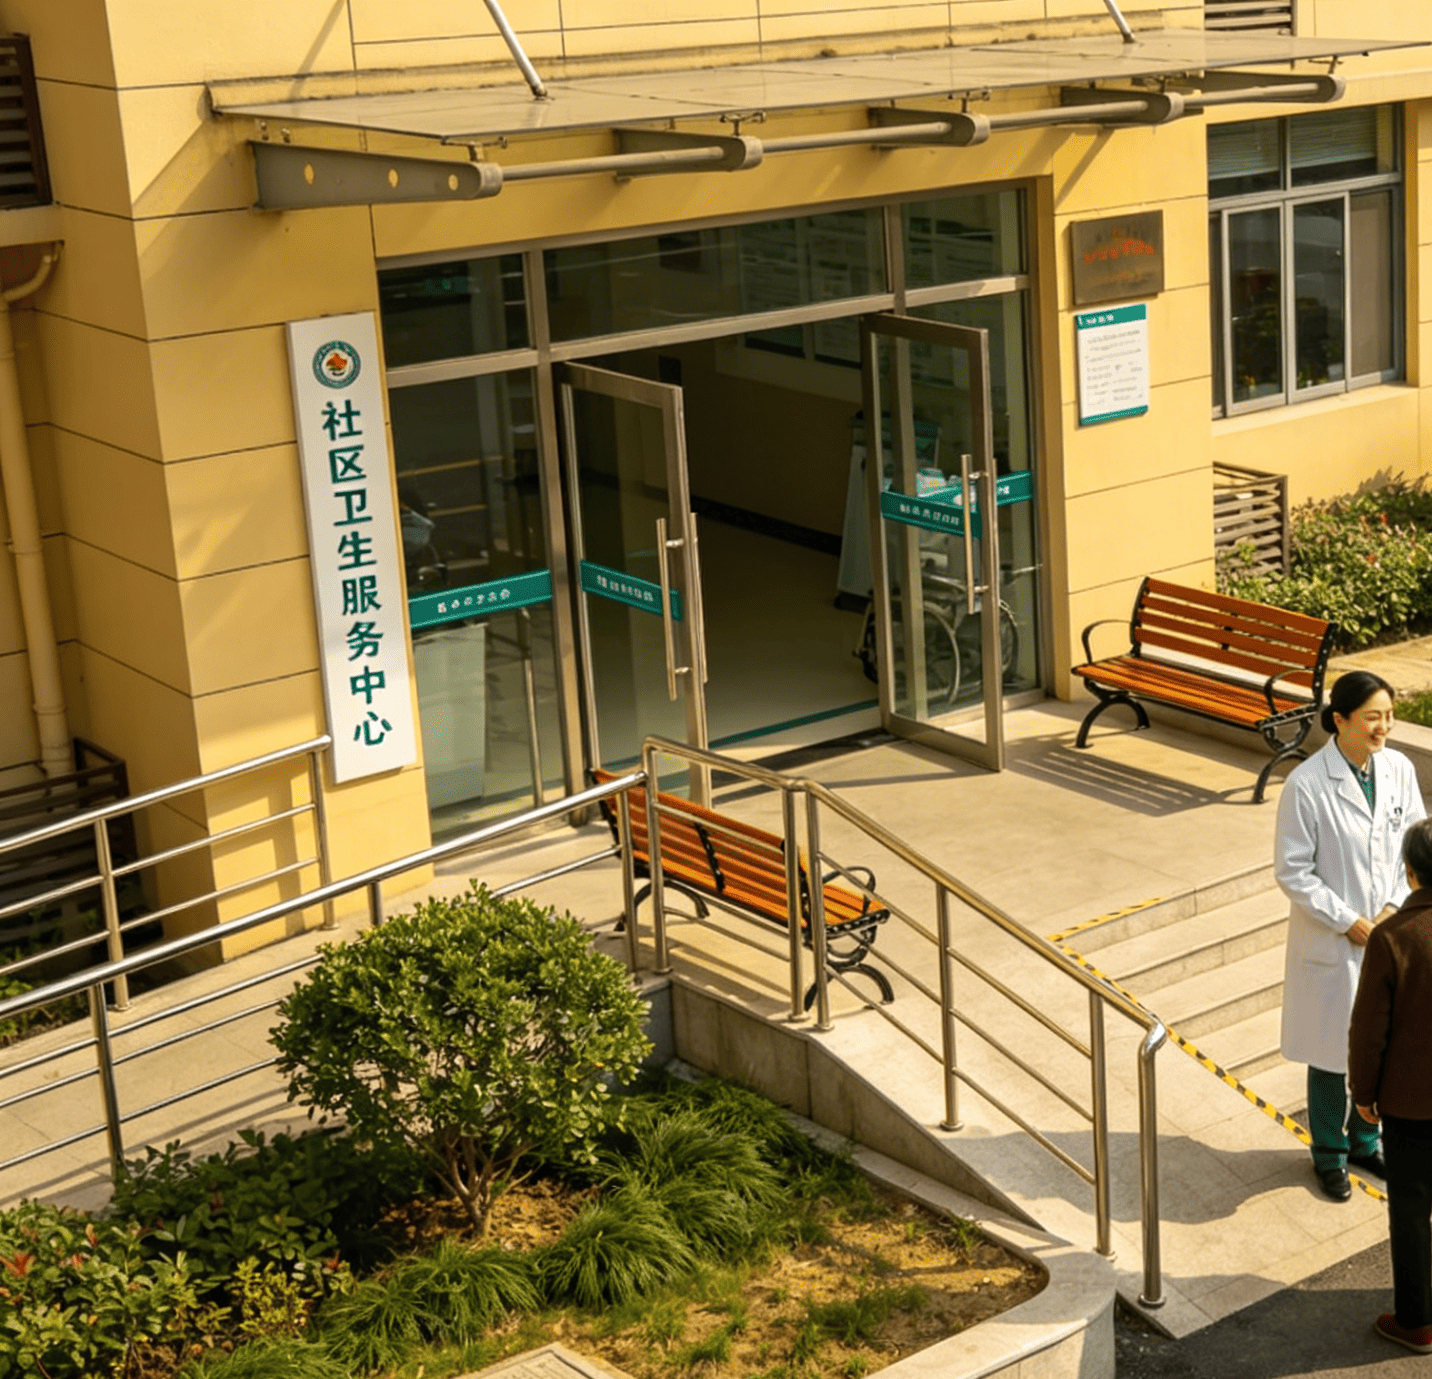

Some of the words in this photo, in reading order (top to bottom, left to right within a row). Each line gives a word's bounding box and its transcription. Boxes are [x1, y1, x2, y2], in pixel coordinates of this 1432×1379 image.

[321, 399, 392, 746] 社区卫生服务中心
